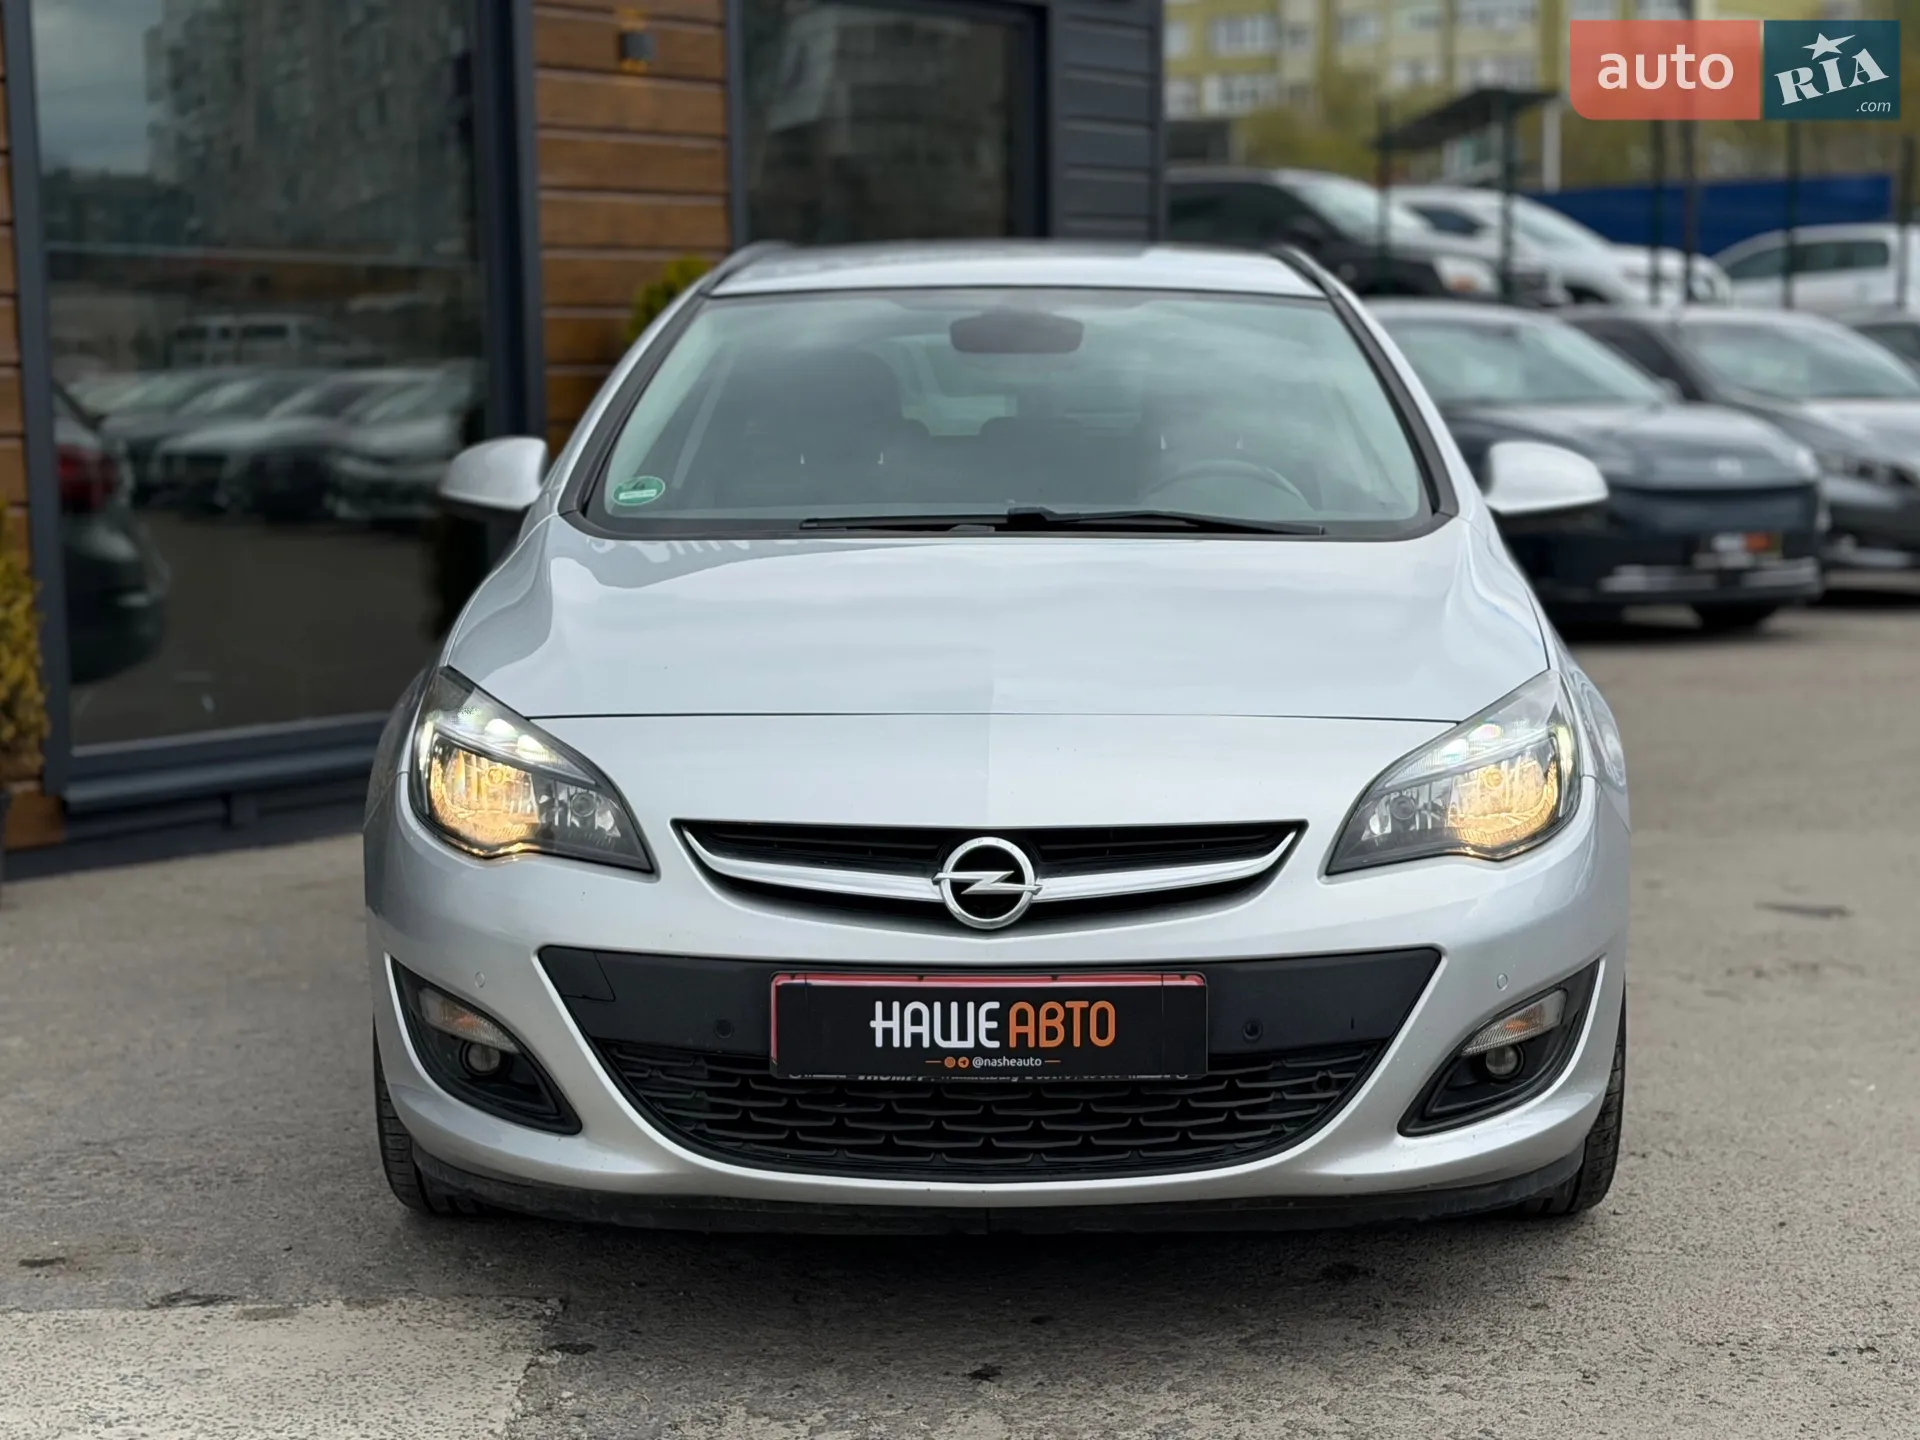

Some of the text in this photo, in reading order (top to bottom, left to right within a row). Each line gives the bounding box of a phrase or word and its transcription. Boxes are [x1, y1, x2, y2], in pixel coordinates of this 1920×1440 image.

[869, 1000, 1116, 1049] НАШЕ АВТО
[972, 1056, 1042, 1069] @nasheauto
